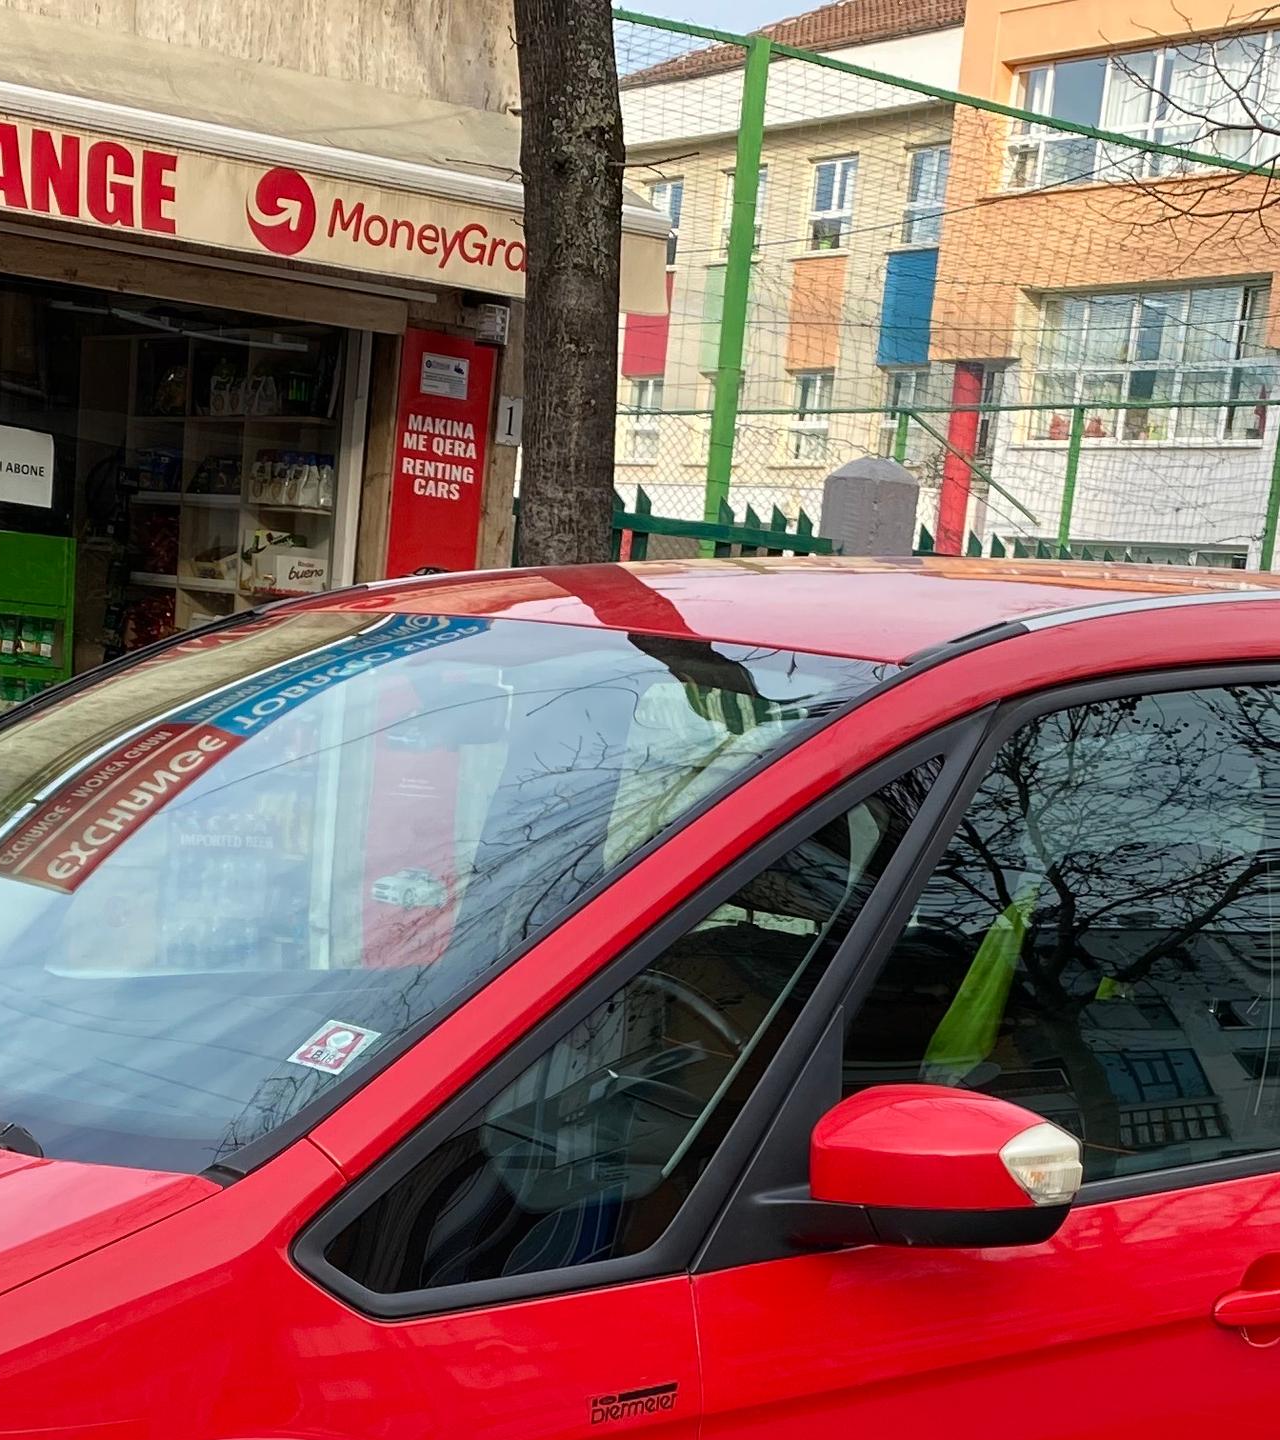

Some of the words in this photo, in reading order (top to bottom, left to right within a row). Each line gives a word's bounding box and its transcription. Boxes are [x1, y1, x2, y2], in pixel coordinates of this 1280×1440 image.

[327, 198, 527, 273] MoneyGra
[408, 413, 475, 440] MAKINA
[504, 405, 514, 437] 1
[403, 432, 427, 452] ME
[432, 438, 477, 460] QERA
[6, 460, 46, 478] ABONE
[402, 457, 475, 484] RENTING
[413, 478, 461, 501] CARS
[287, 566, 324, 581] bueno
